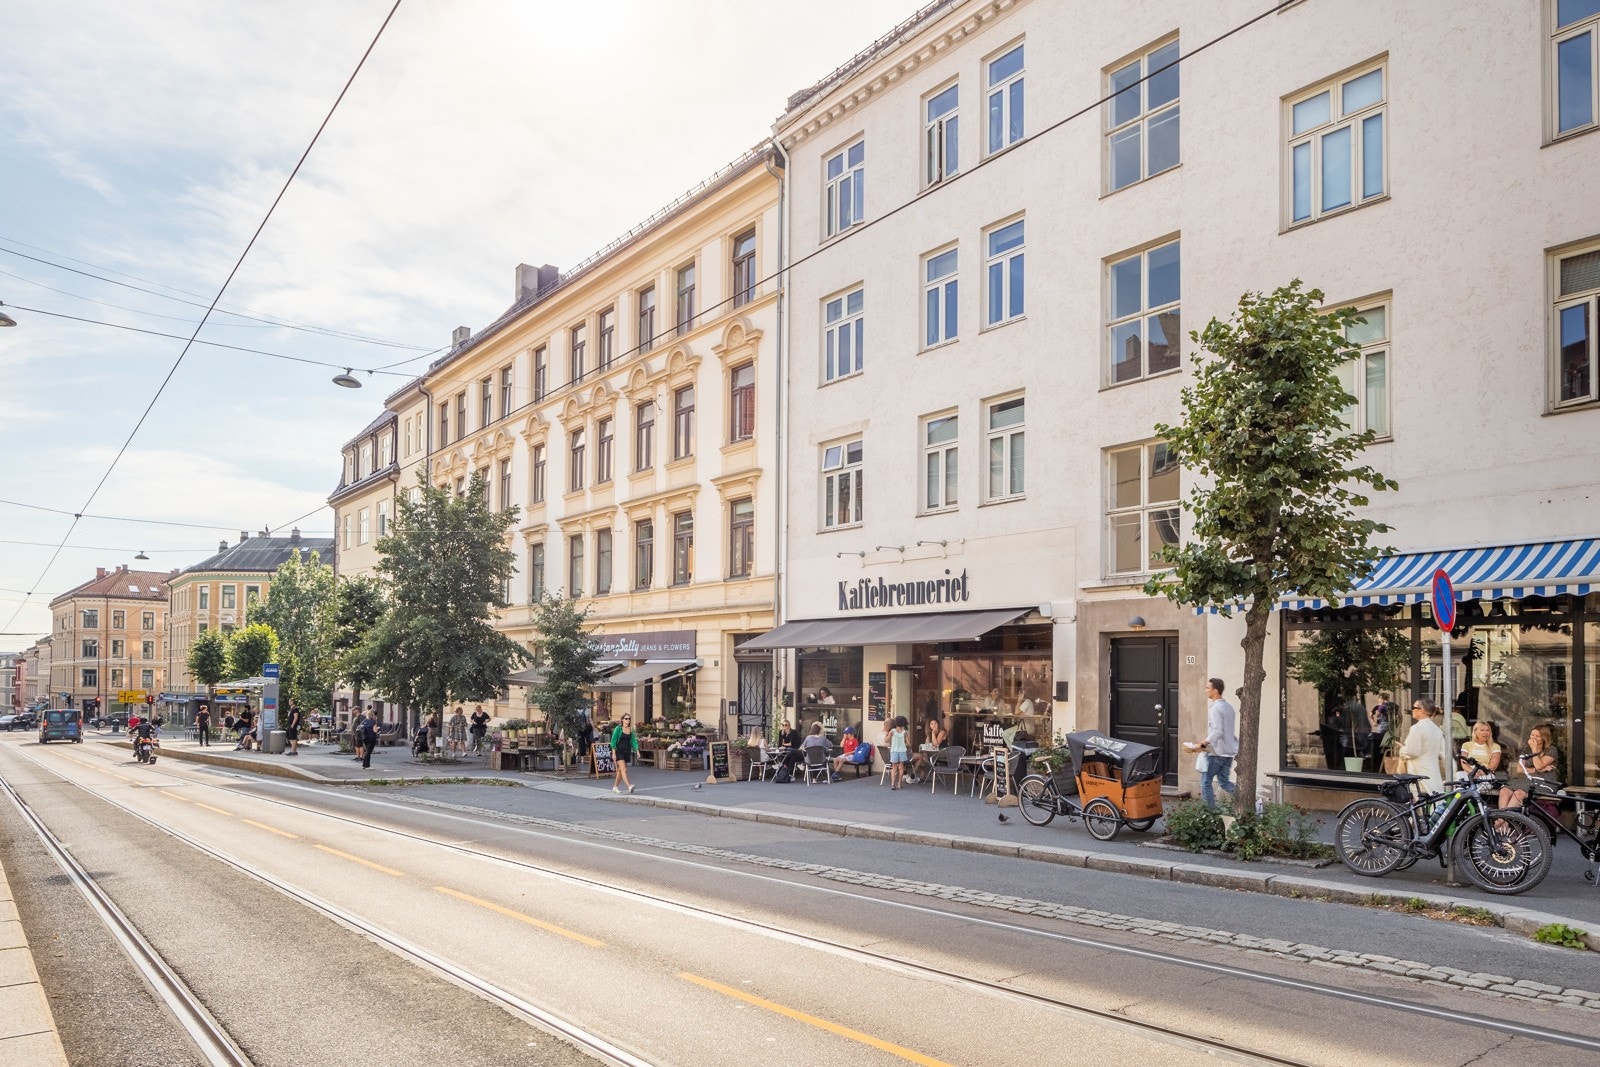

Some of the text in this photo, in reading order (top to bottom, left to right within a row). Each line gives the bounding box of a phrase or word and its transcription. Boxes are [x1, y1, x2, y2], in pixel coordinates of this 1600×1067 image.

[838, 568, 970, 611] Kaffebrenneriet
[640, 643, 657, 652] JEANS
[659, 643, 662, 651] &
[664, 643, 690, 651] FLOWERS
[1187, 656, 1195, 664] 50
[984, 723, 1004, 737] Kaffe
